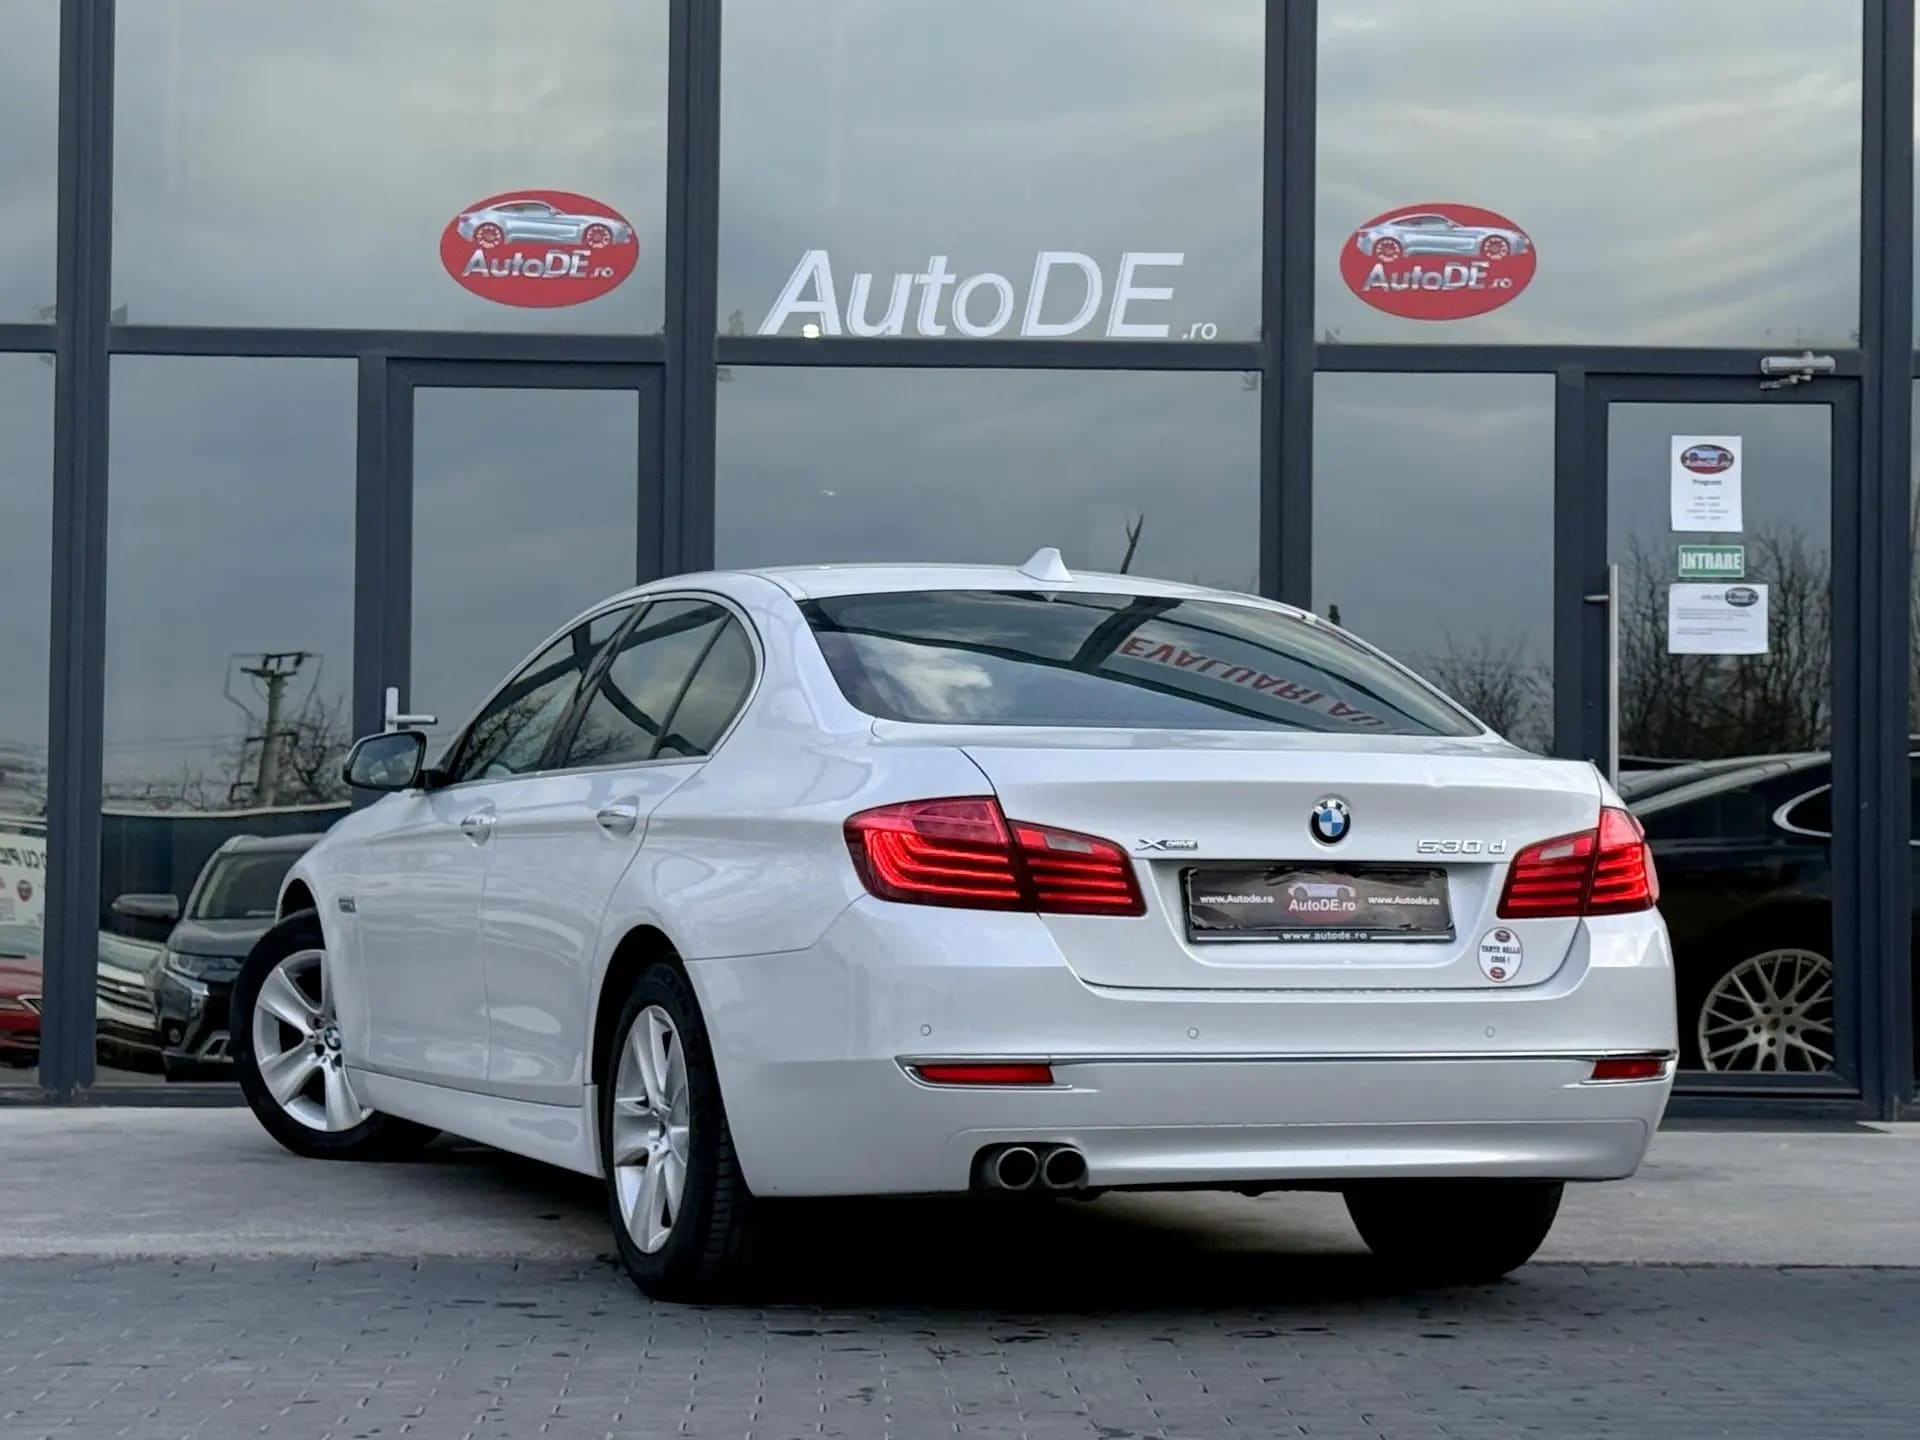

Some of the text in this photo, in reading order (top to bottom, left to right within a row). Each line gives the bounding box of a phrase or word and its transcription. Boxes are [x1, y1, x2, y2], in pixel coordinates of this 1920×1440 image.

[1681, 552, 1742, 569] INTRARE
[1417, 839, 1507, 854] 530 d
[1287, 898, 1356, 911] AutoDE.ro
[1281, 931, 1368, 940] www.autode.ro
